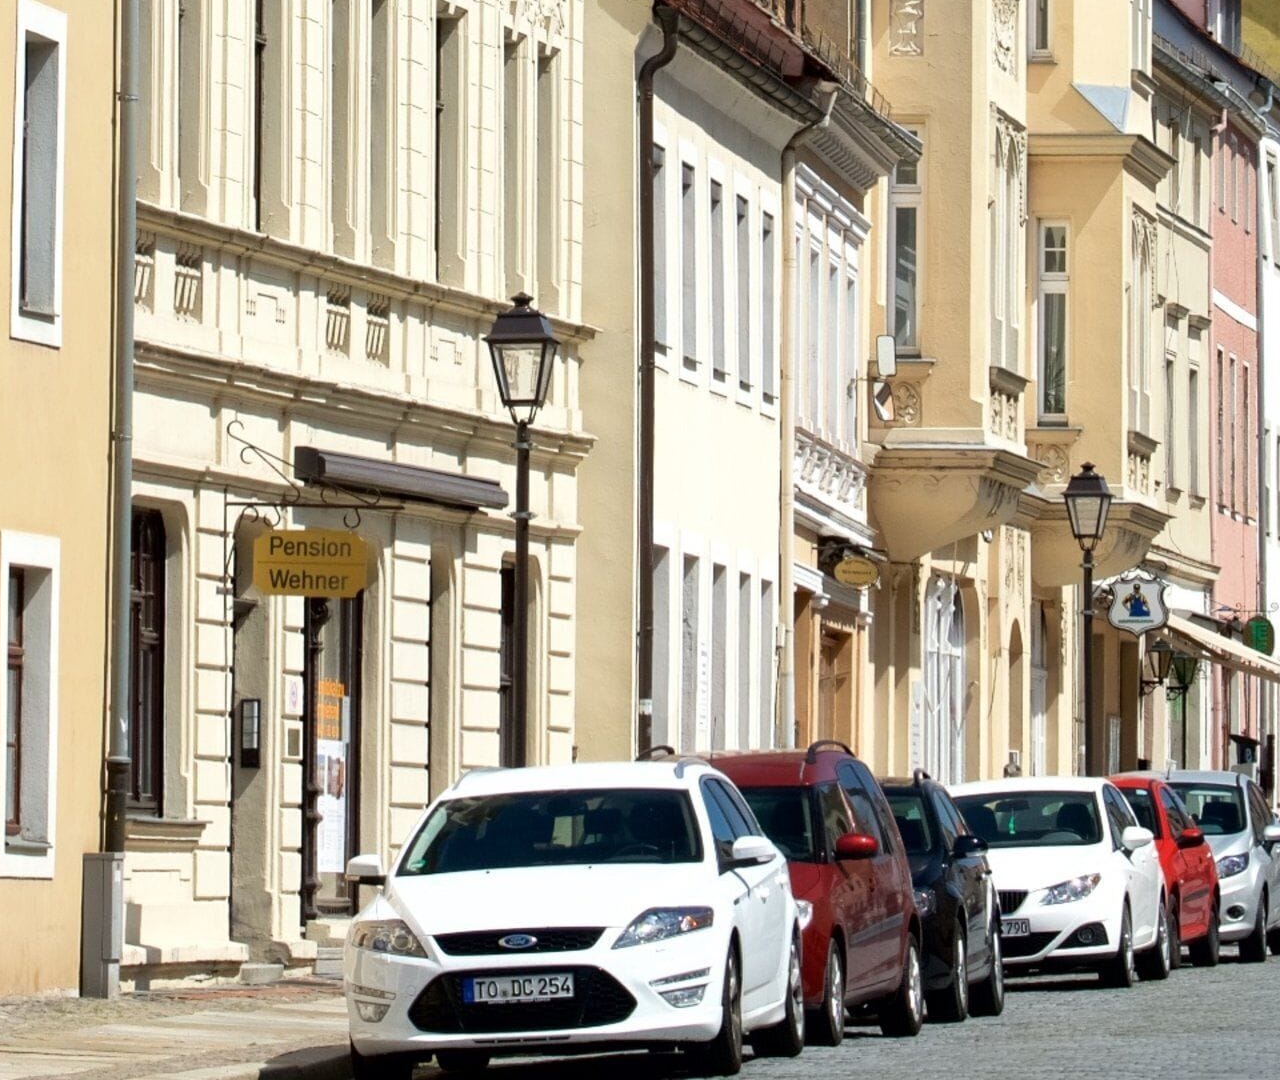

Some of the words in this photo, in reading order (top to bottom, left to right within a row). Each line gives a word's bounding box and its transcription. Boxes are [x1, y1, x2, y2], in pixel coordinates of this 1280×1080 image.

[269, 536, 352, 557] Pension
[269, 569, 349, 590] Wehner
[475, 980, 498, 999] TO
[511, 978, 534, 997] DC
[538, 976, 571, 996] 254
